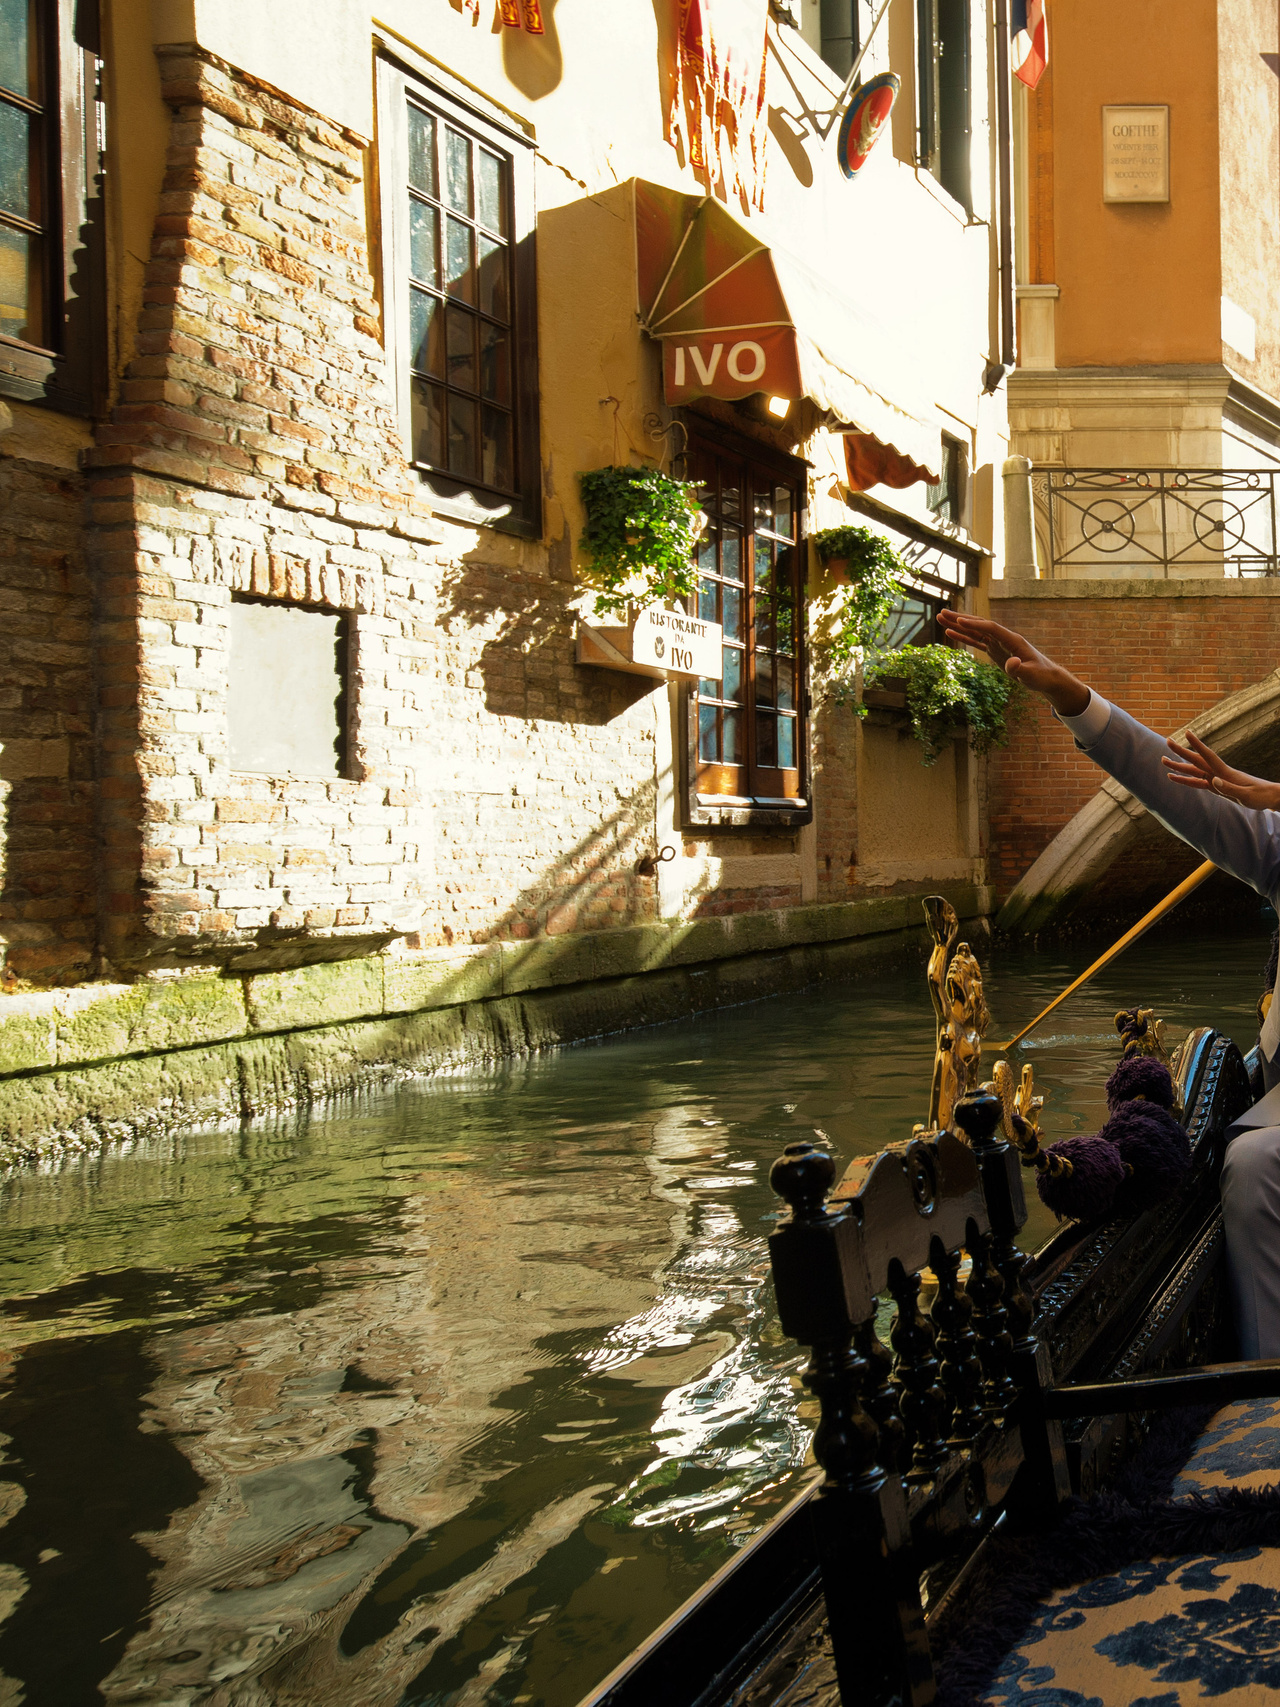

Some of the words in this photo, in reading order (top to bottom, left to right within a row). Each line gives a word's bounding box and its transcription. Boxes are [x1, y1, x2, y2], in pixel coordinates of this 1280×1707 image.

[1112, 124, 1159, 137] GOETHE
[674, 340, 766, 386] IVO
[649, 611, 708, 638] RISTORANTE
[671, 647, 693, 670] IVO
